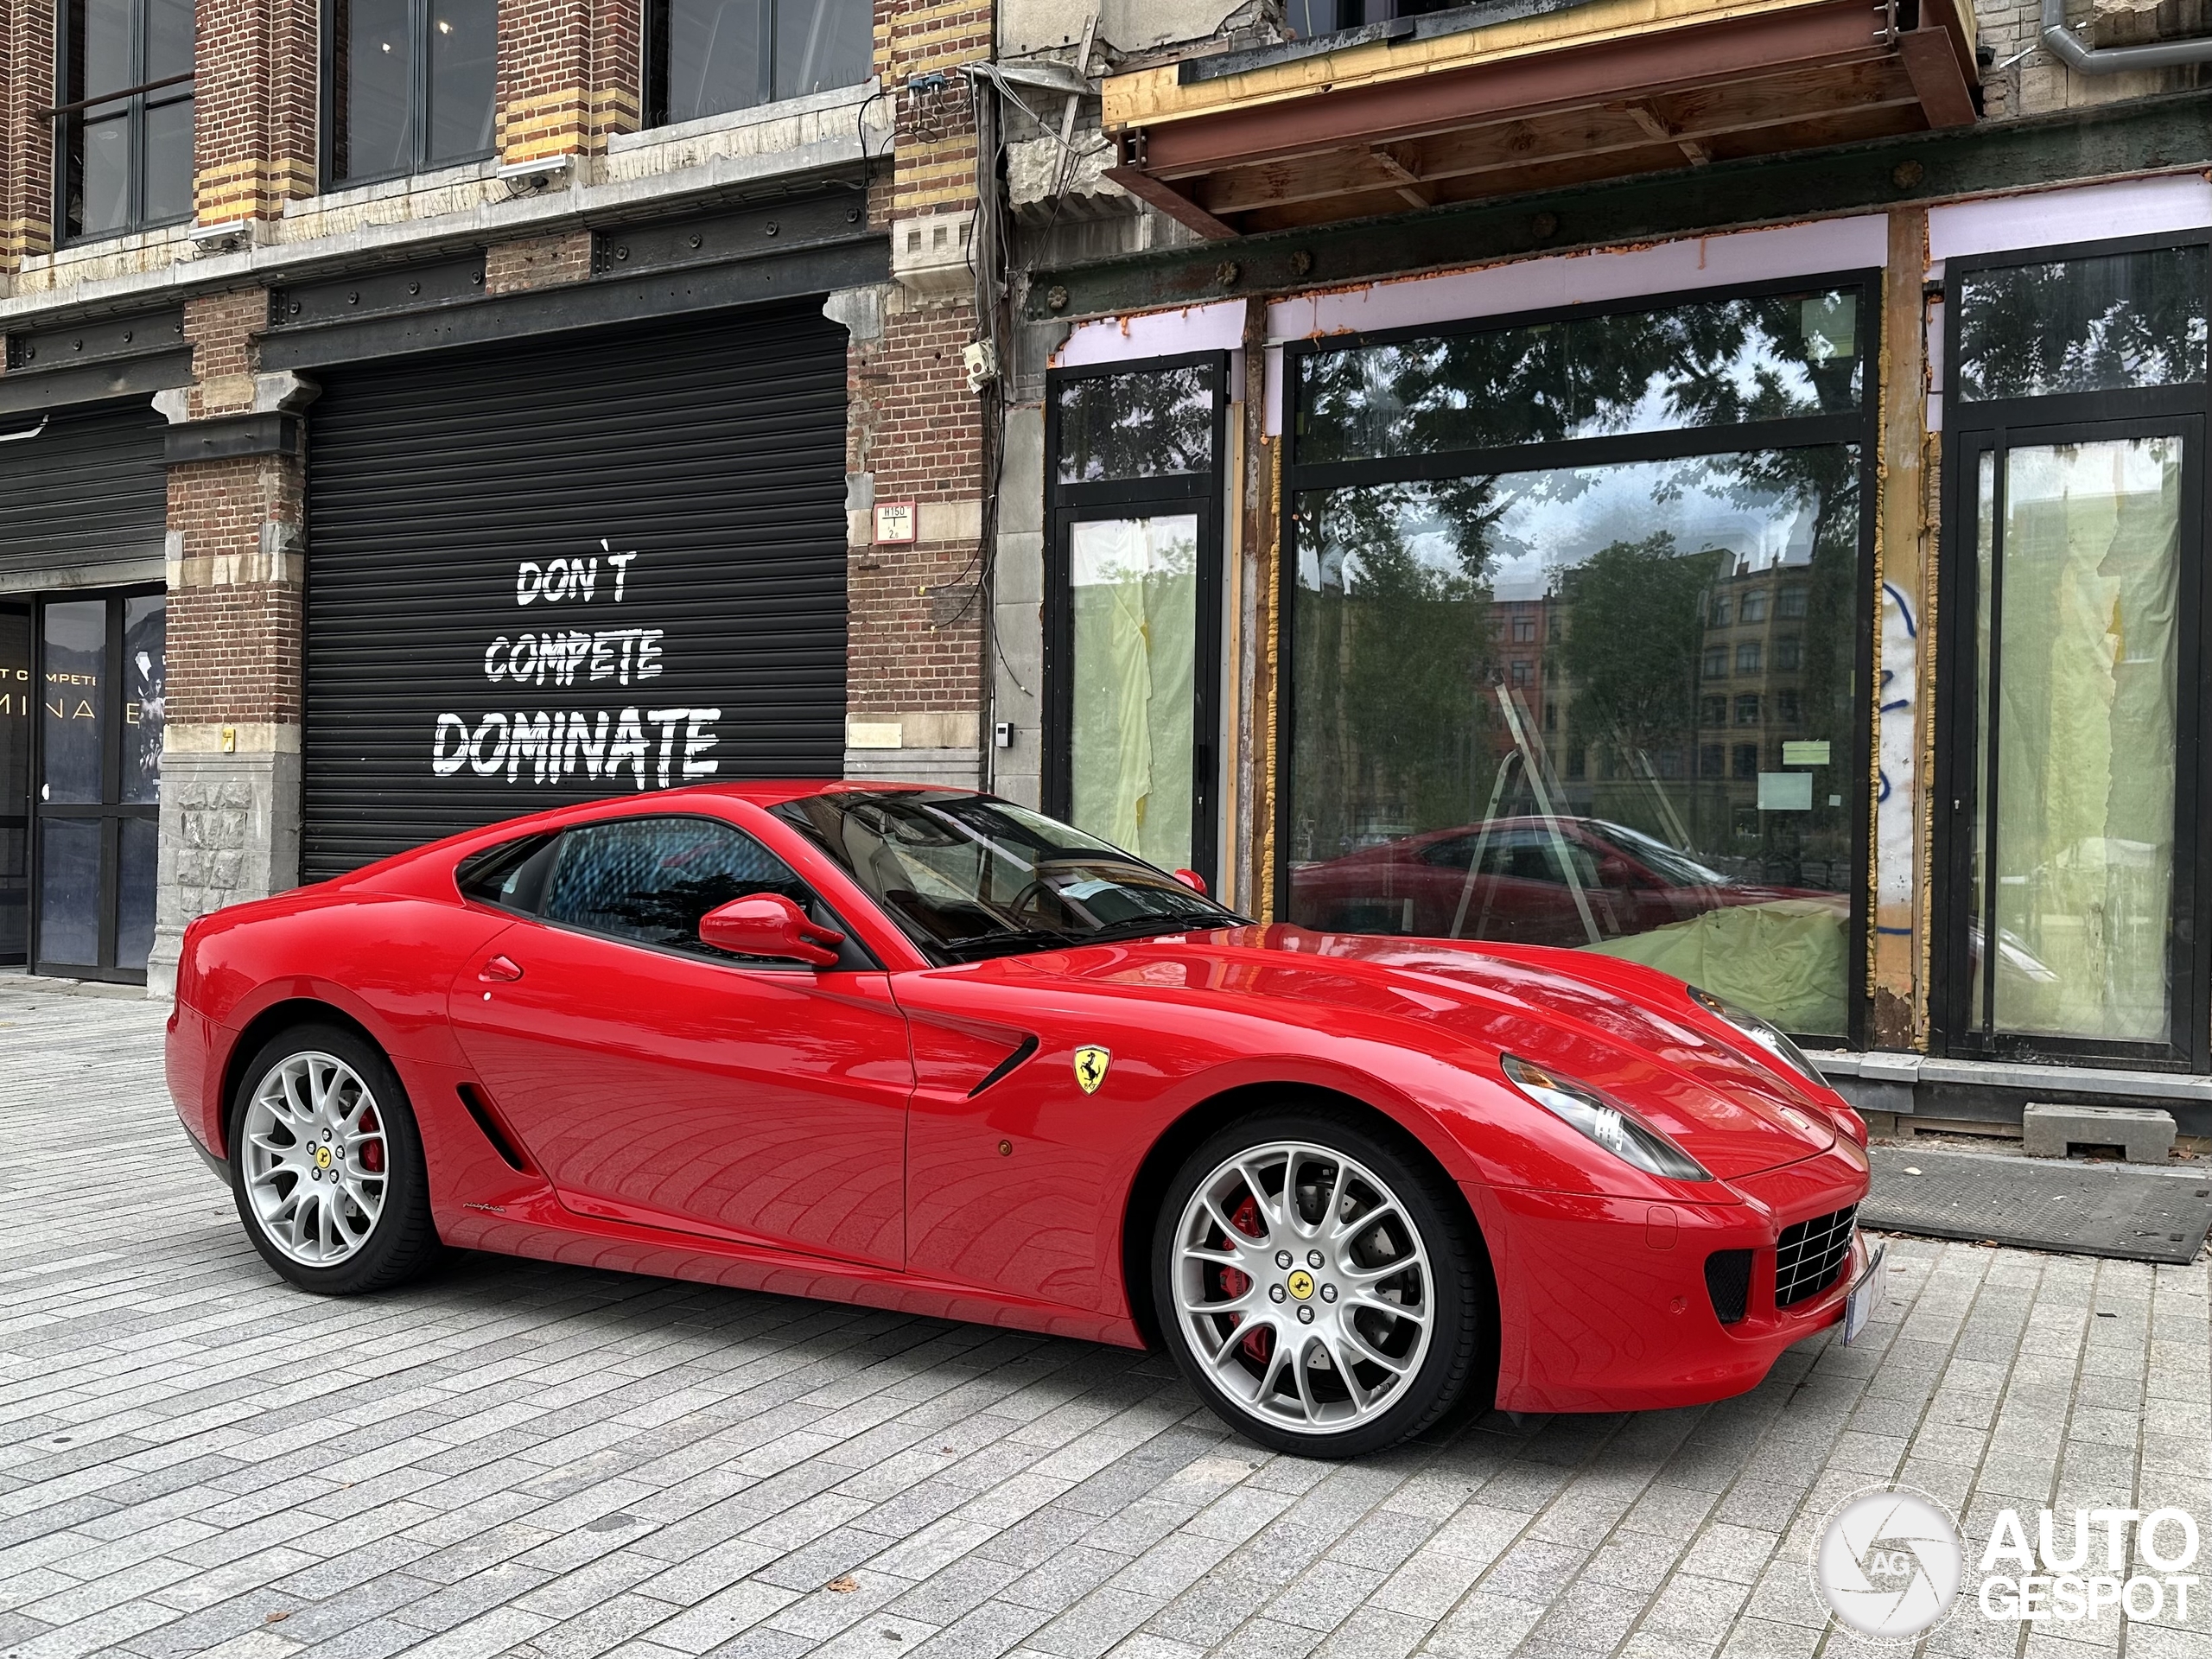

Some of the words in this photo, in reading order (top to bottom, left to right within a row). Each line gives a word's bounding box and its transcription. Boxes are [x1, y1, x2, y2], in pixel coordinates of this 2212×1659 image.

[516, 538, 638, 606] DON'T
[484, 628, 664, 686] COMPETE
[432, 706, 722, 791] DOMINATE
